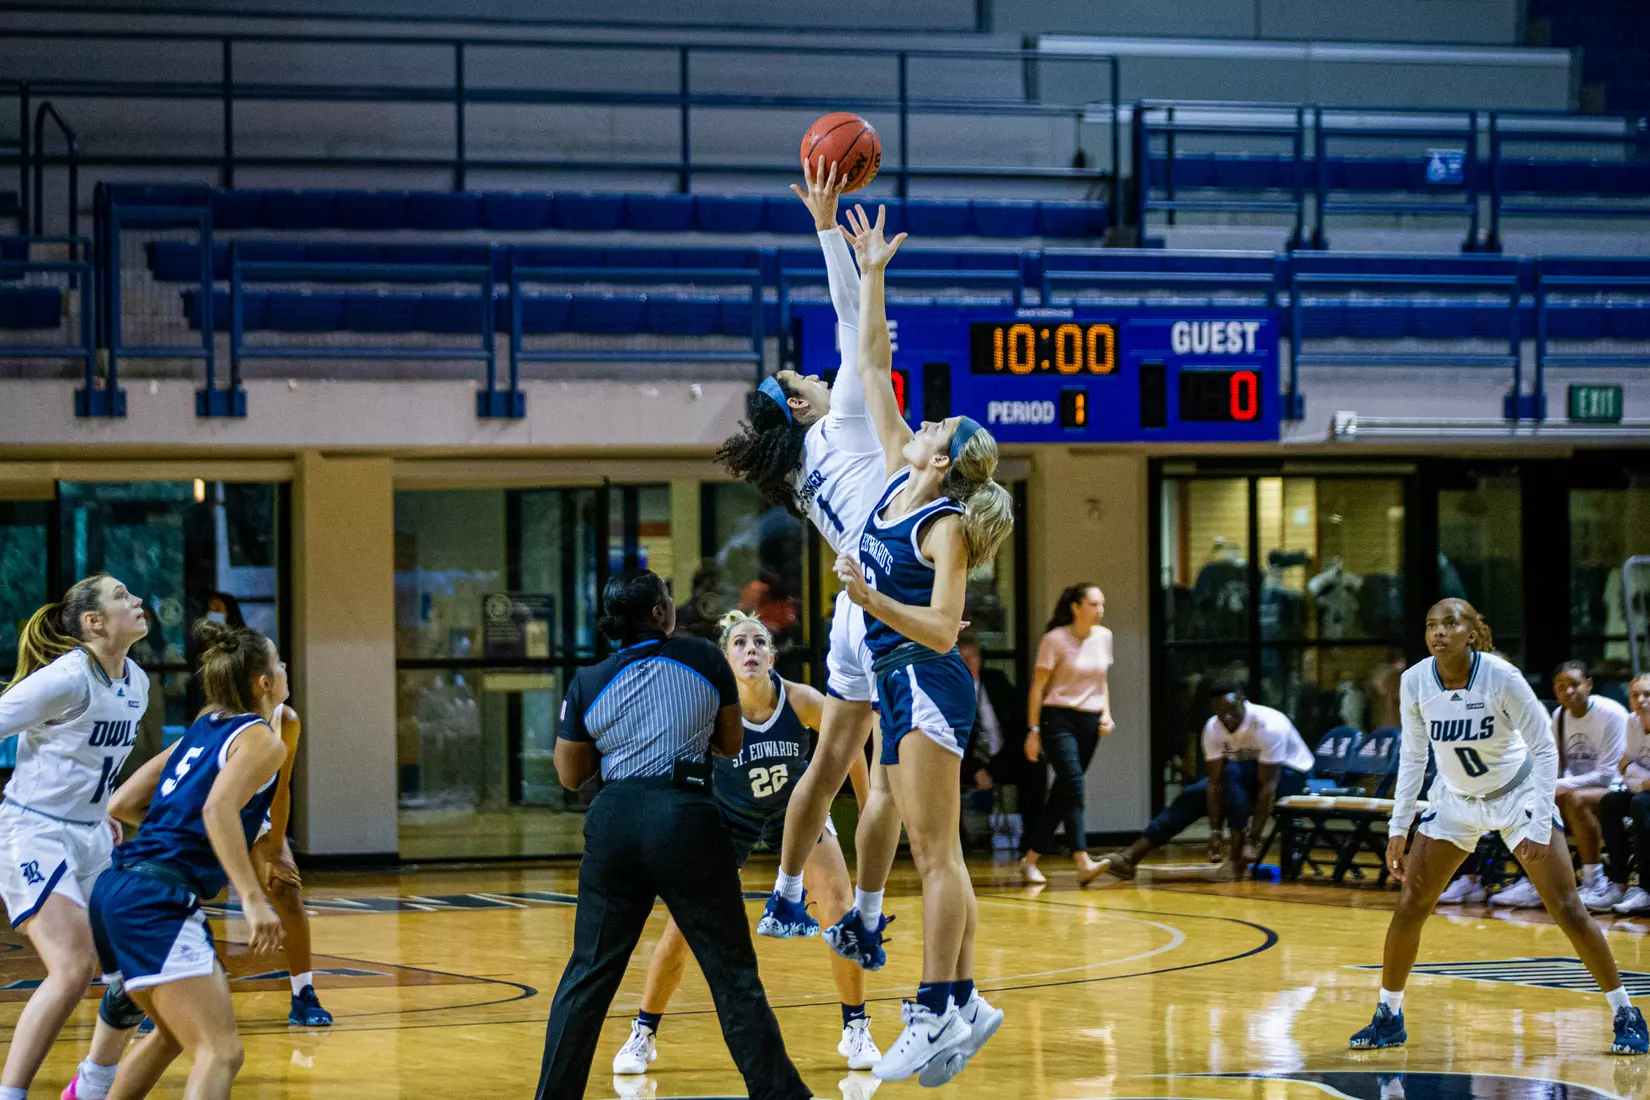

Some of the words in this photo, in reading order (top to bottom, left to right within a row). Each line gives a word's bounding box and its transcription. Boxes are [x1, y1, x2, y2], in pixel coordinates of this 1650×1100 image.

[993, 323, 1115, 375] 10:00
[1171, 321, 1260, 354] GUEST
[987, 400, 1056, 425] PERIOD
[1075, 393, 1085, 425] 1
[1230, 371, 1257, 421] 0
[816, 494, 845, 534] 1
[1430, 716, 1495, 742] OWLS
[749, 740, 799, 761] EDWARD'S
[1454, 747, 1489, 778] 0
[160, 746, 205, 797] 5
[748, 763, 789, 798] 22
